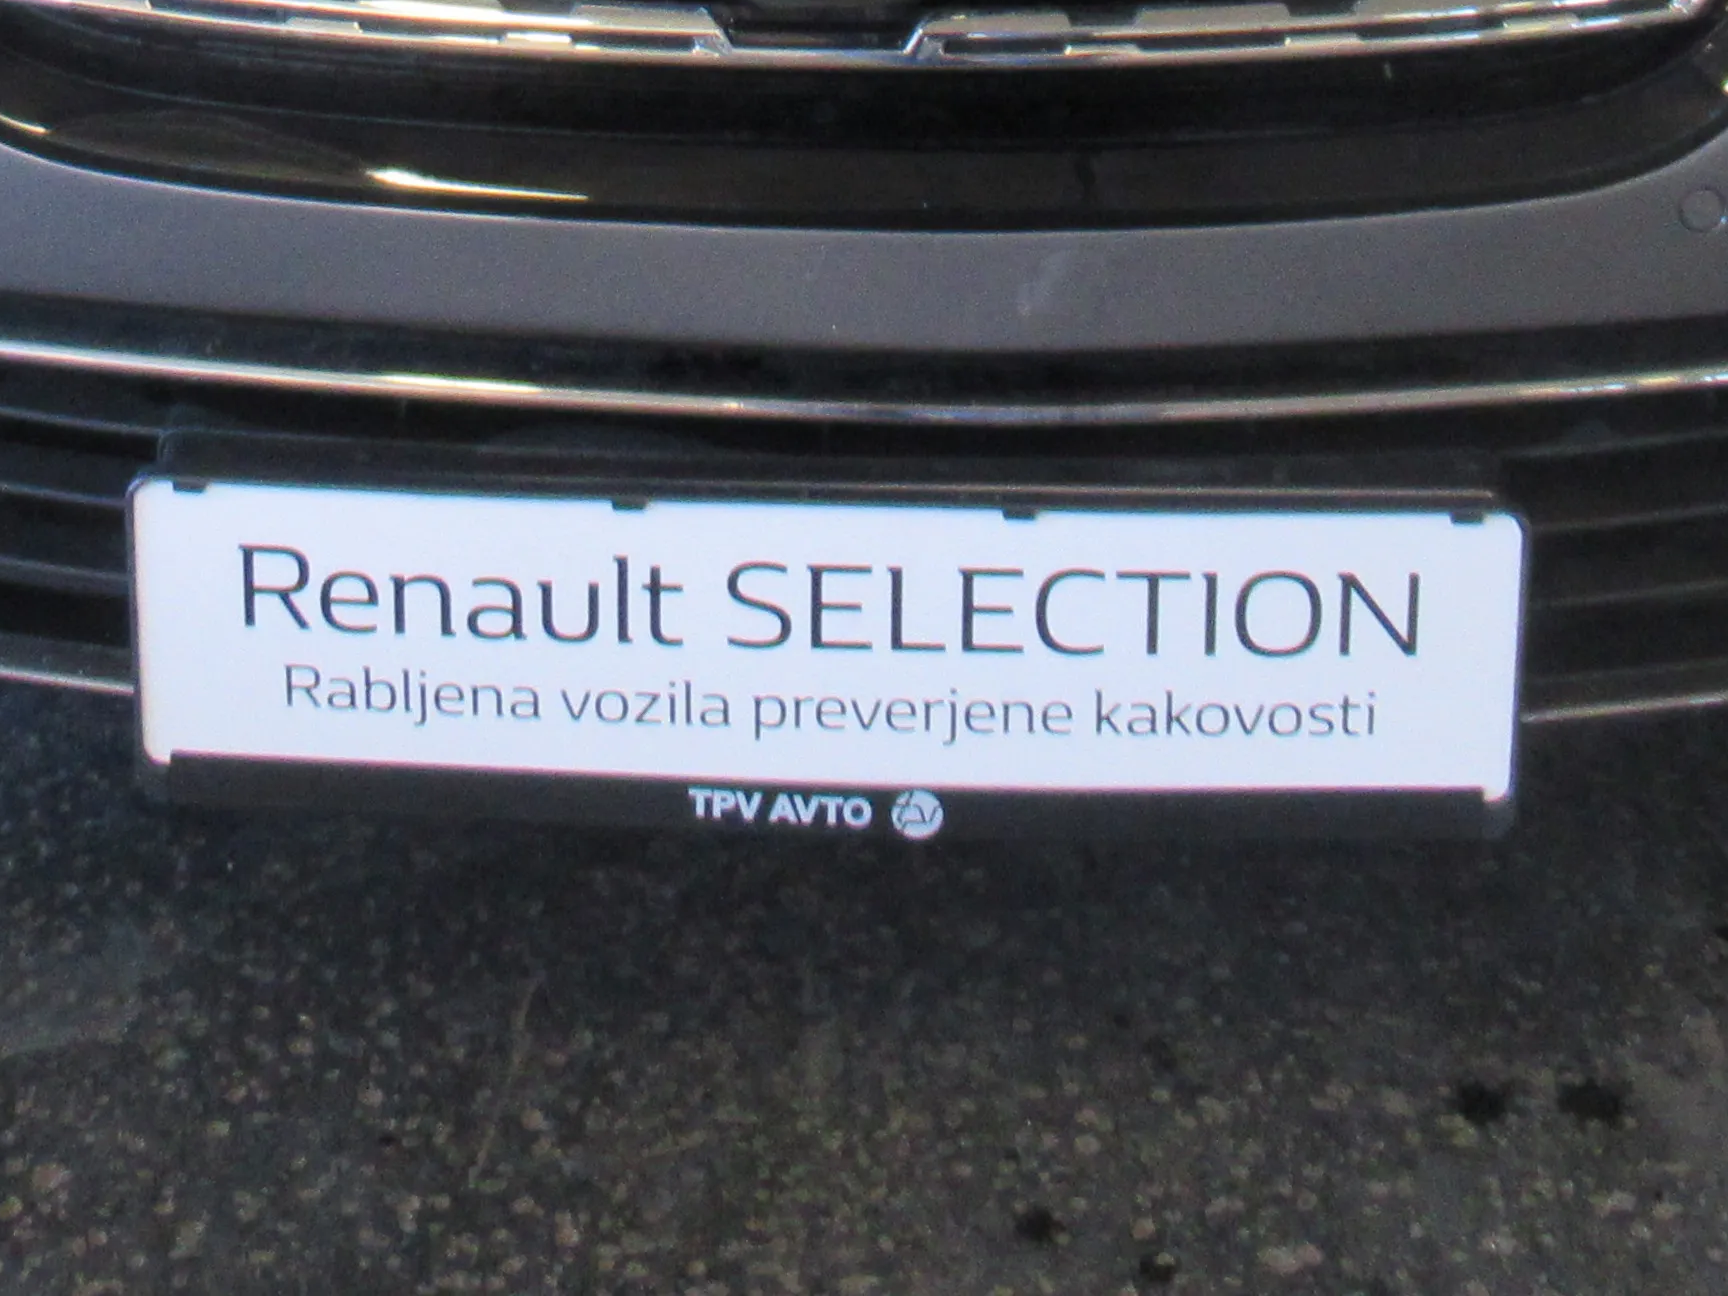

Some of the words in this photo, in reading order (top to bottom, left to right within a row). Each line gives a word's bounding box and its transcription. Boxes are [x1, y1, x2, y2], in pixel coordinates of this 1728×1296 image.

[238, 543, 684, 647] Renault
[725, 560, 1420, 658] SELECTION
[284, 663, 541, 726] Rabljena
[560, 679, 731, 727] vozila
[752, 687, 1073, 745] preverjene
[1094, 688, 1376, 737] kakovosti
[688, 786, 763, 823] TPV
[768, 792, 873, 829] AVTO
